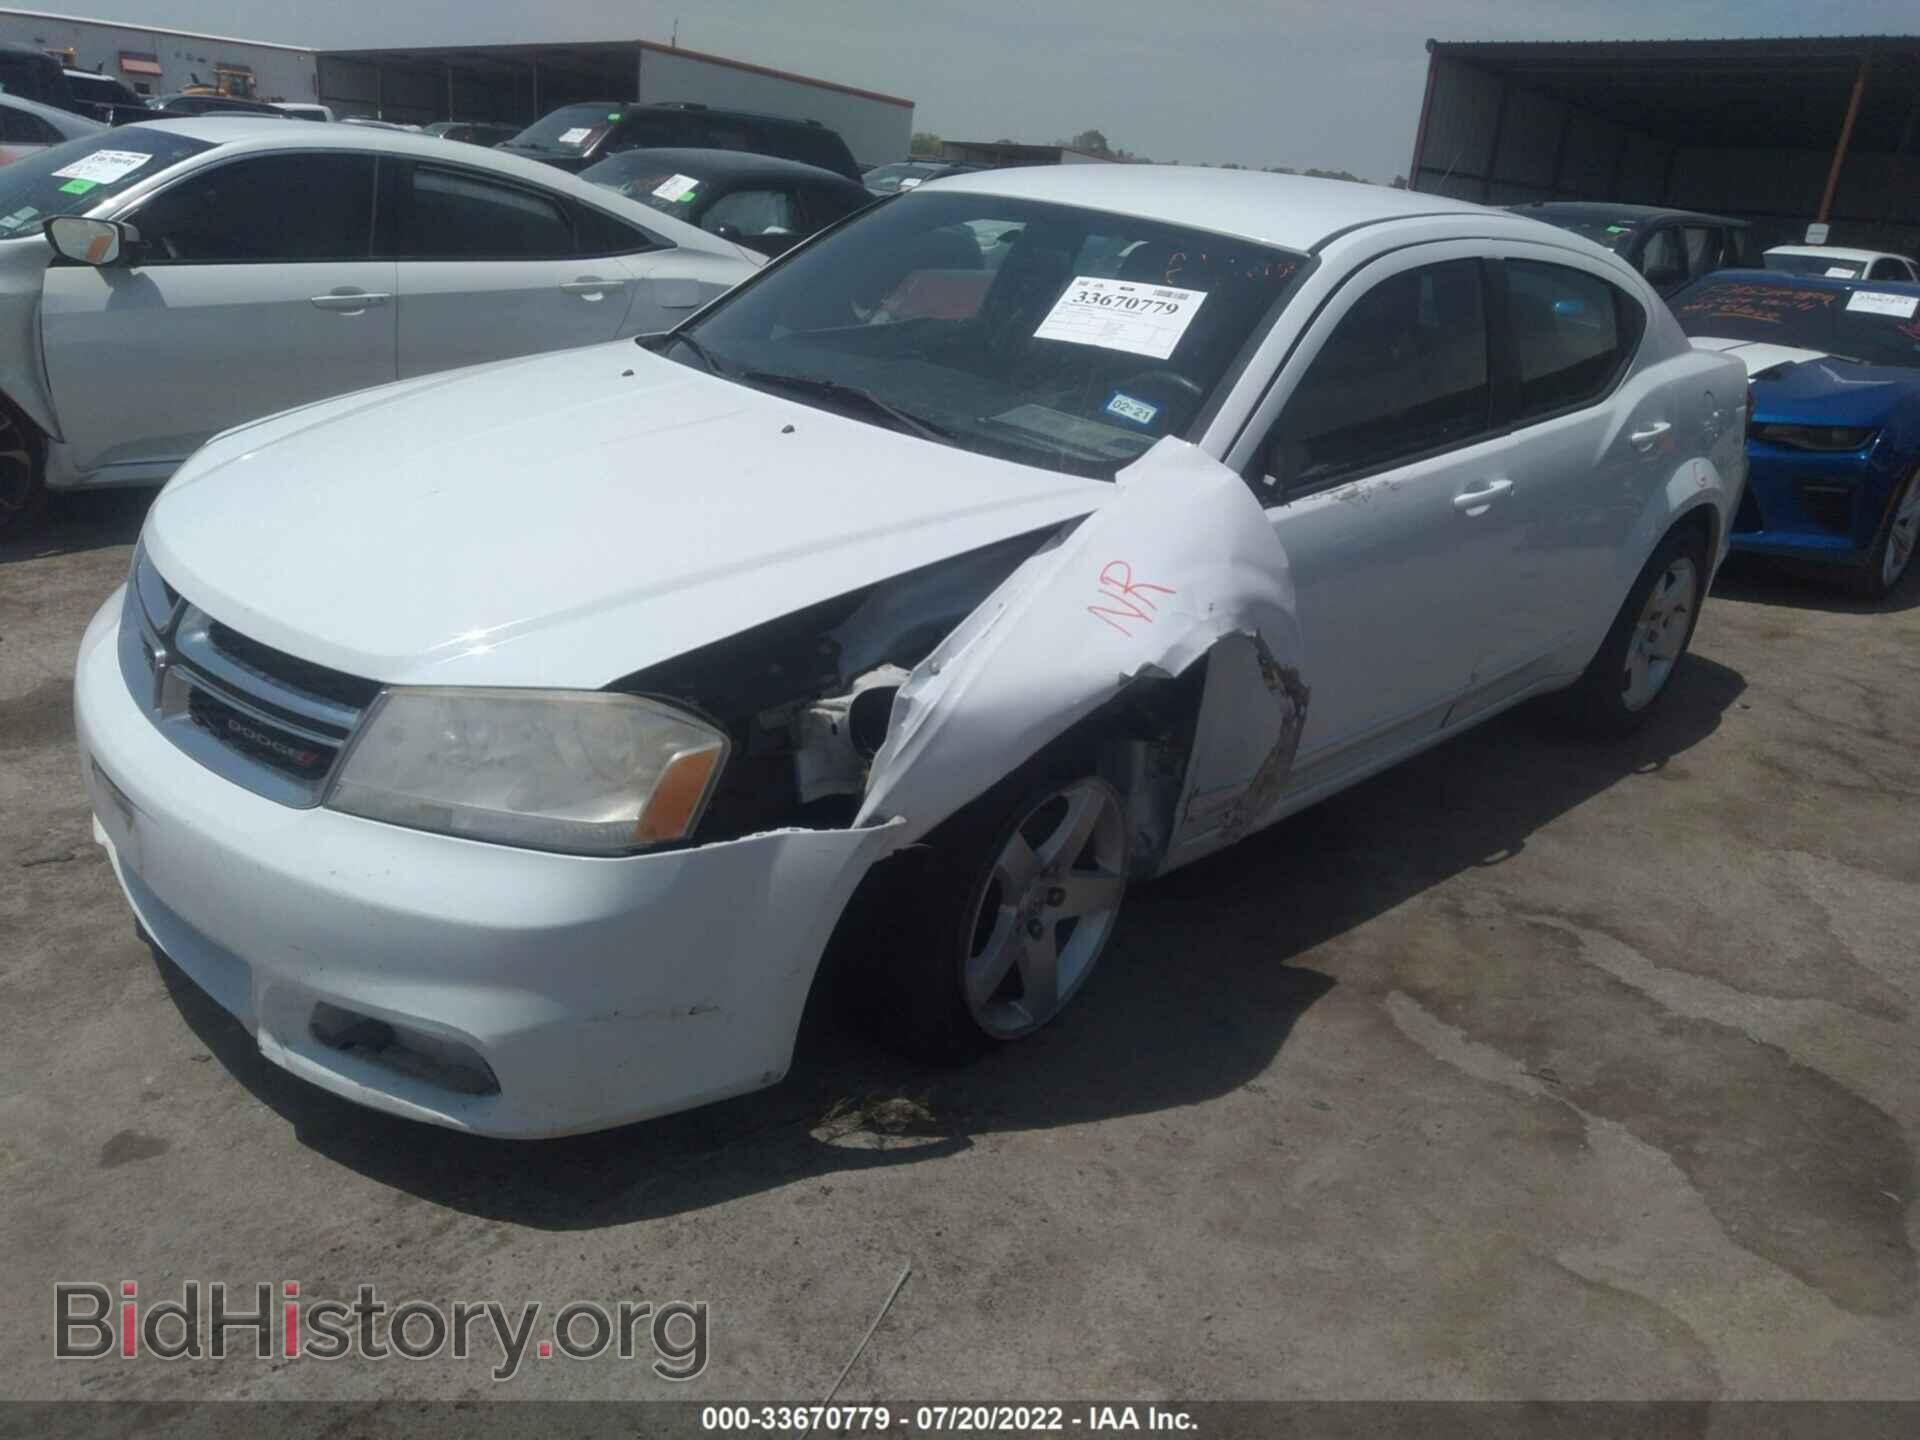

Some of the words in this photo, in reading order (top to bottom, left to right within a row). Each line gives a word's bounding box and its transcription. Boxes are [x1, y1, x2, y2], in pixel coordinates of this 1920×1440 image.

[1072, 290, 1179, 315] 33670779
[1086, 559, 1177, 638] NR
[228, 719, 301, 759] DODGE
